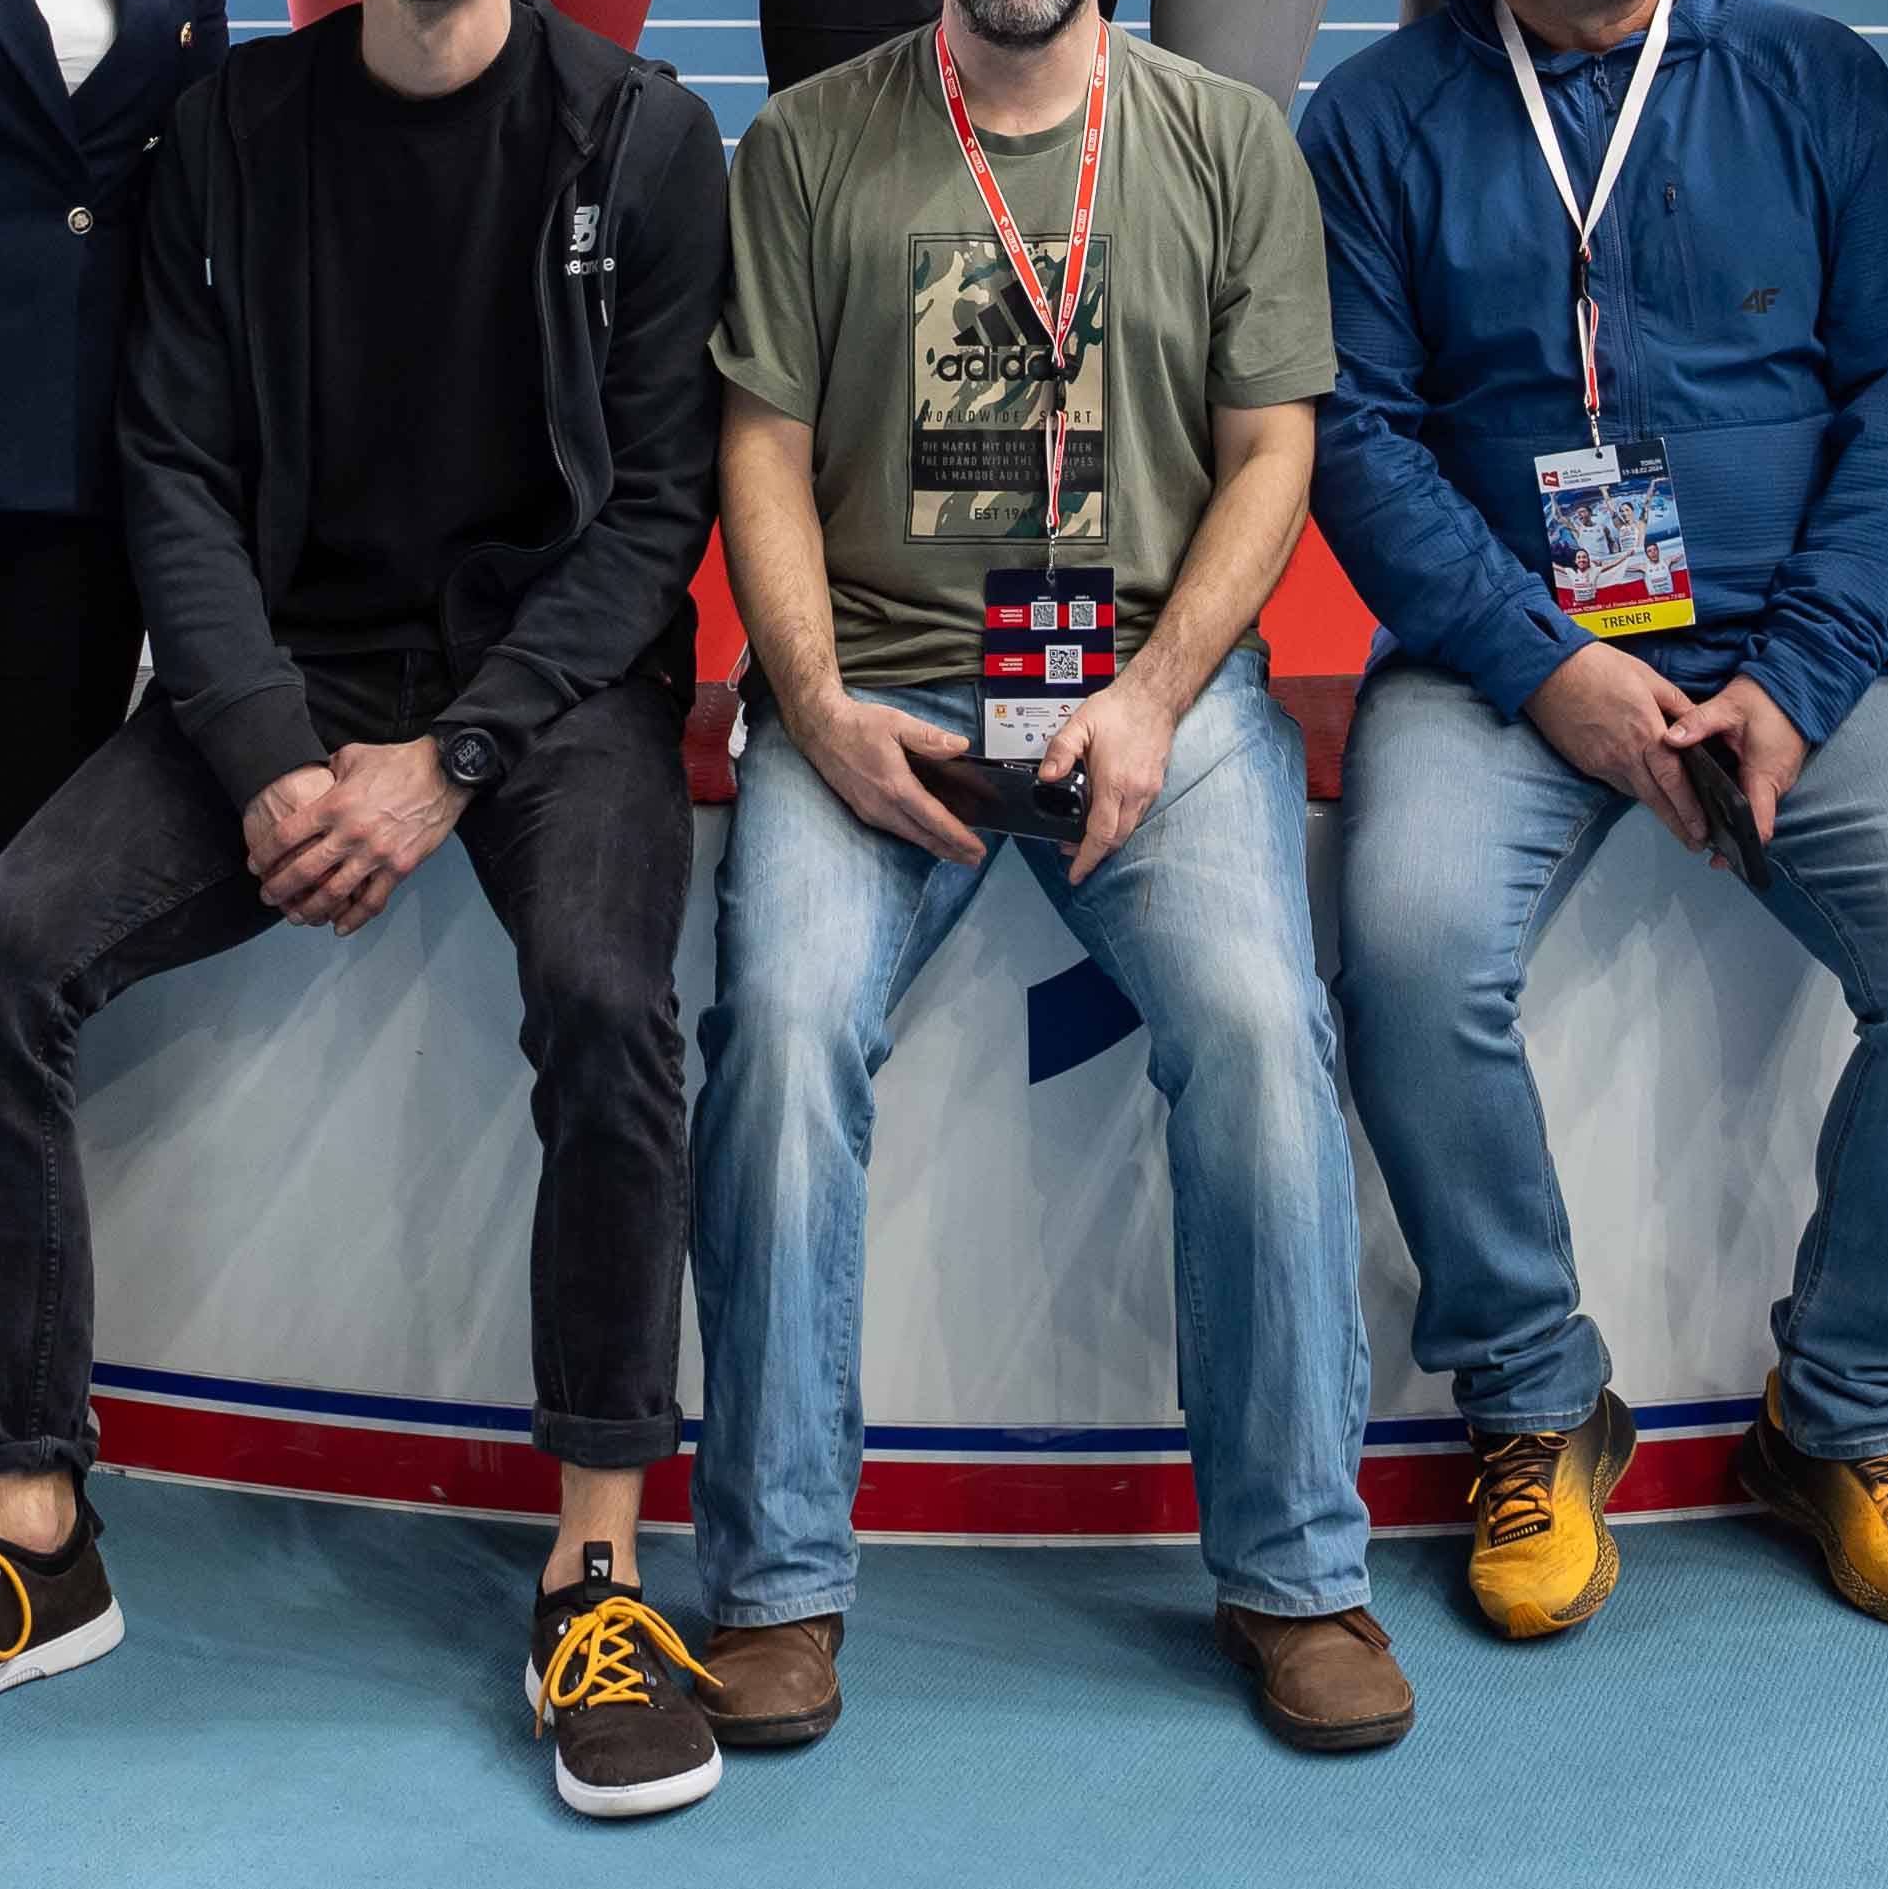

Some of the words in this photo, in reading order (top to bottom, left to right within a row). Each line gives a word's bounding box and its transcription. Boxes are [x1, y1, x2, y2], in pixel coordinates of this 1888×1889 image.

[1039, 410, 1092, 424] SORT
[974, 508, 1001, 520] EST
[1601, 611, 1653, 628] TRENER
